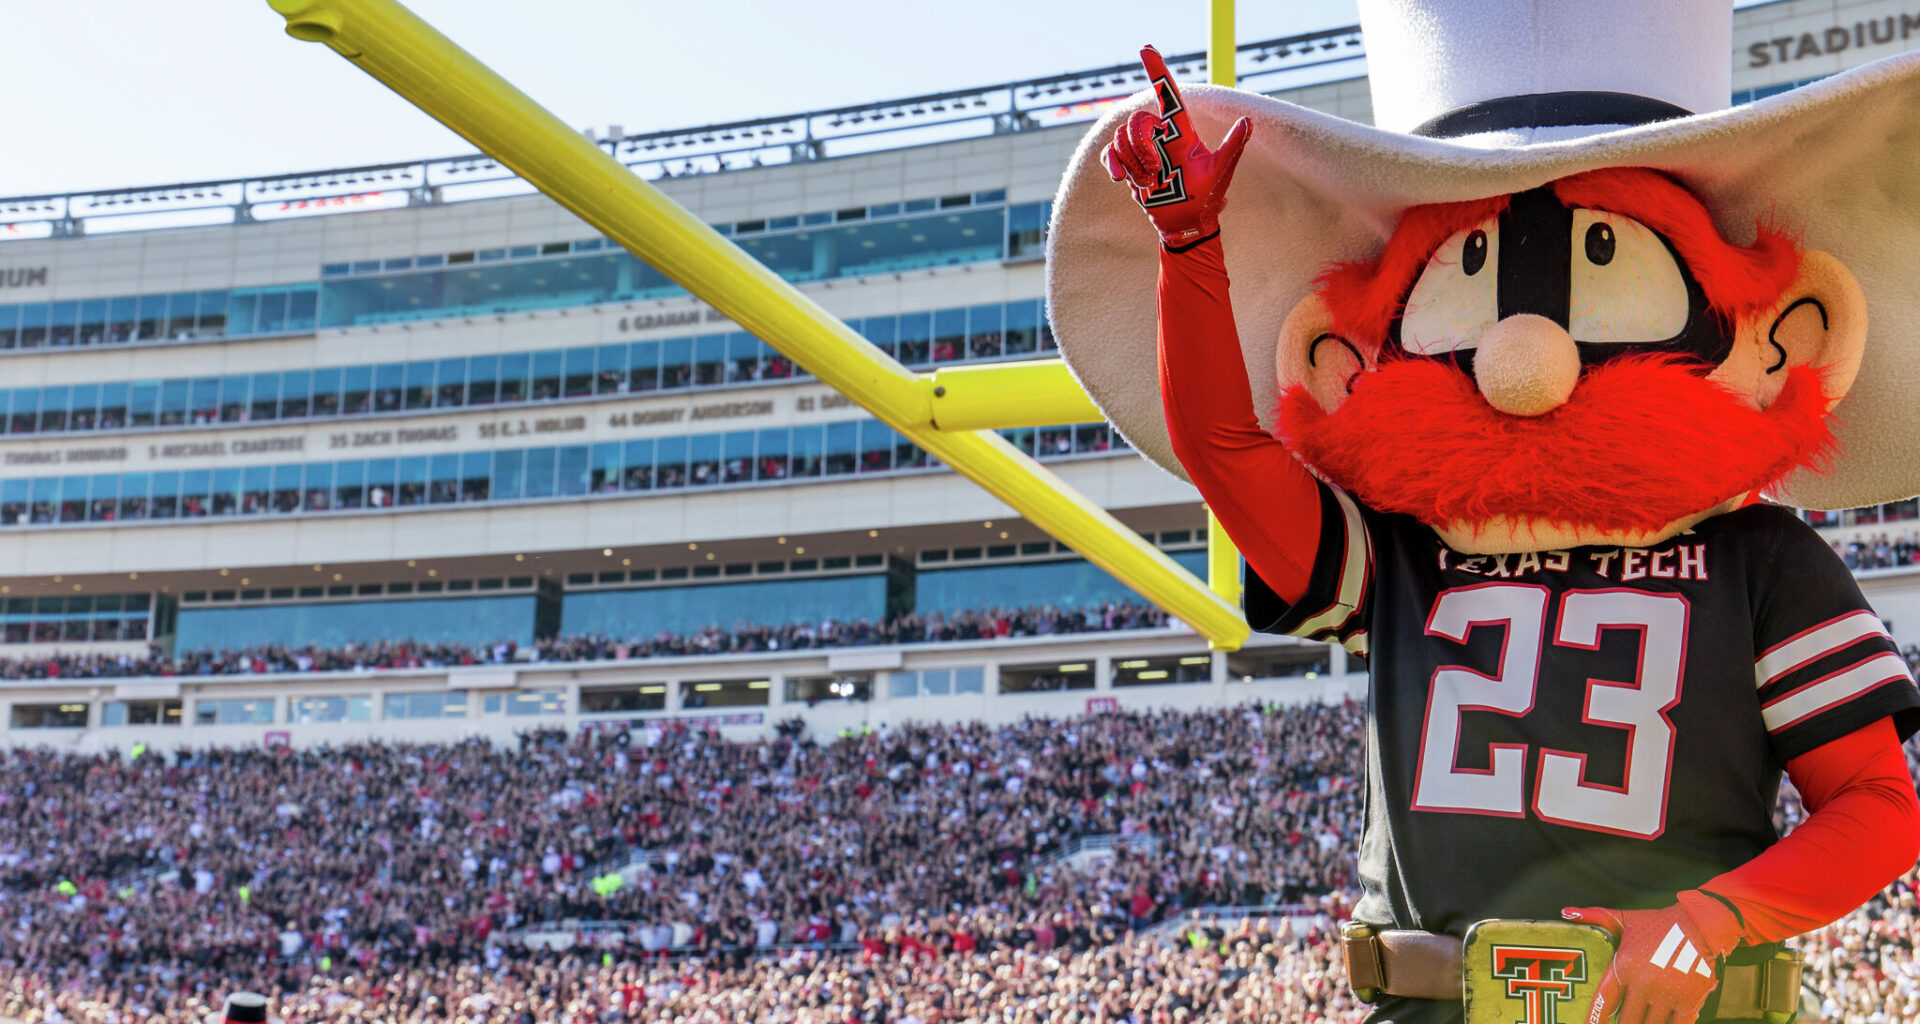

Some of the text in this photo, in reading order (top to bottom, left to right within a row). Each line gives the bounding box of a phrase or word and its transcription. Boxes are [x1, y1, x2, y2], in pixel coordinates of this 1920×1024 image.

[1749, 14, 1920, 68] STADIUM
[634, 311, 699, 331] GRAHAM
[691, 402, 773, 421] ANDERSON
[1591, 544, 1708, 582] TECH
[1410, 582, 1690, 841] 23
[1590, 992, 1605, 1024] ADIZE
